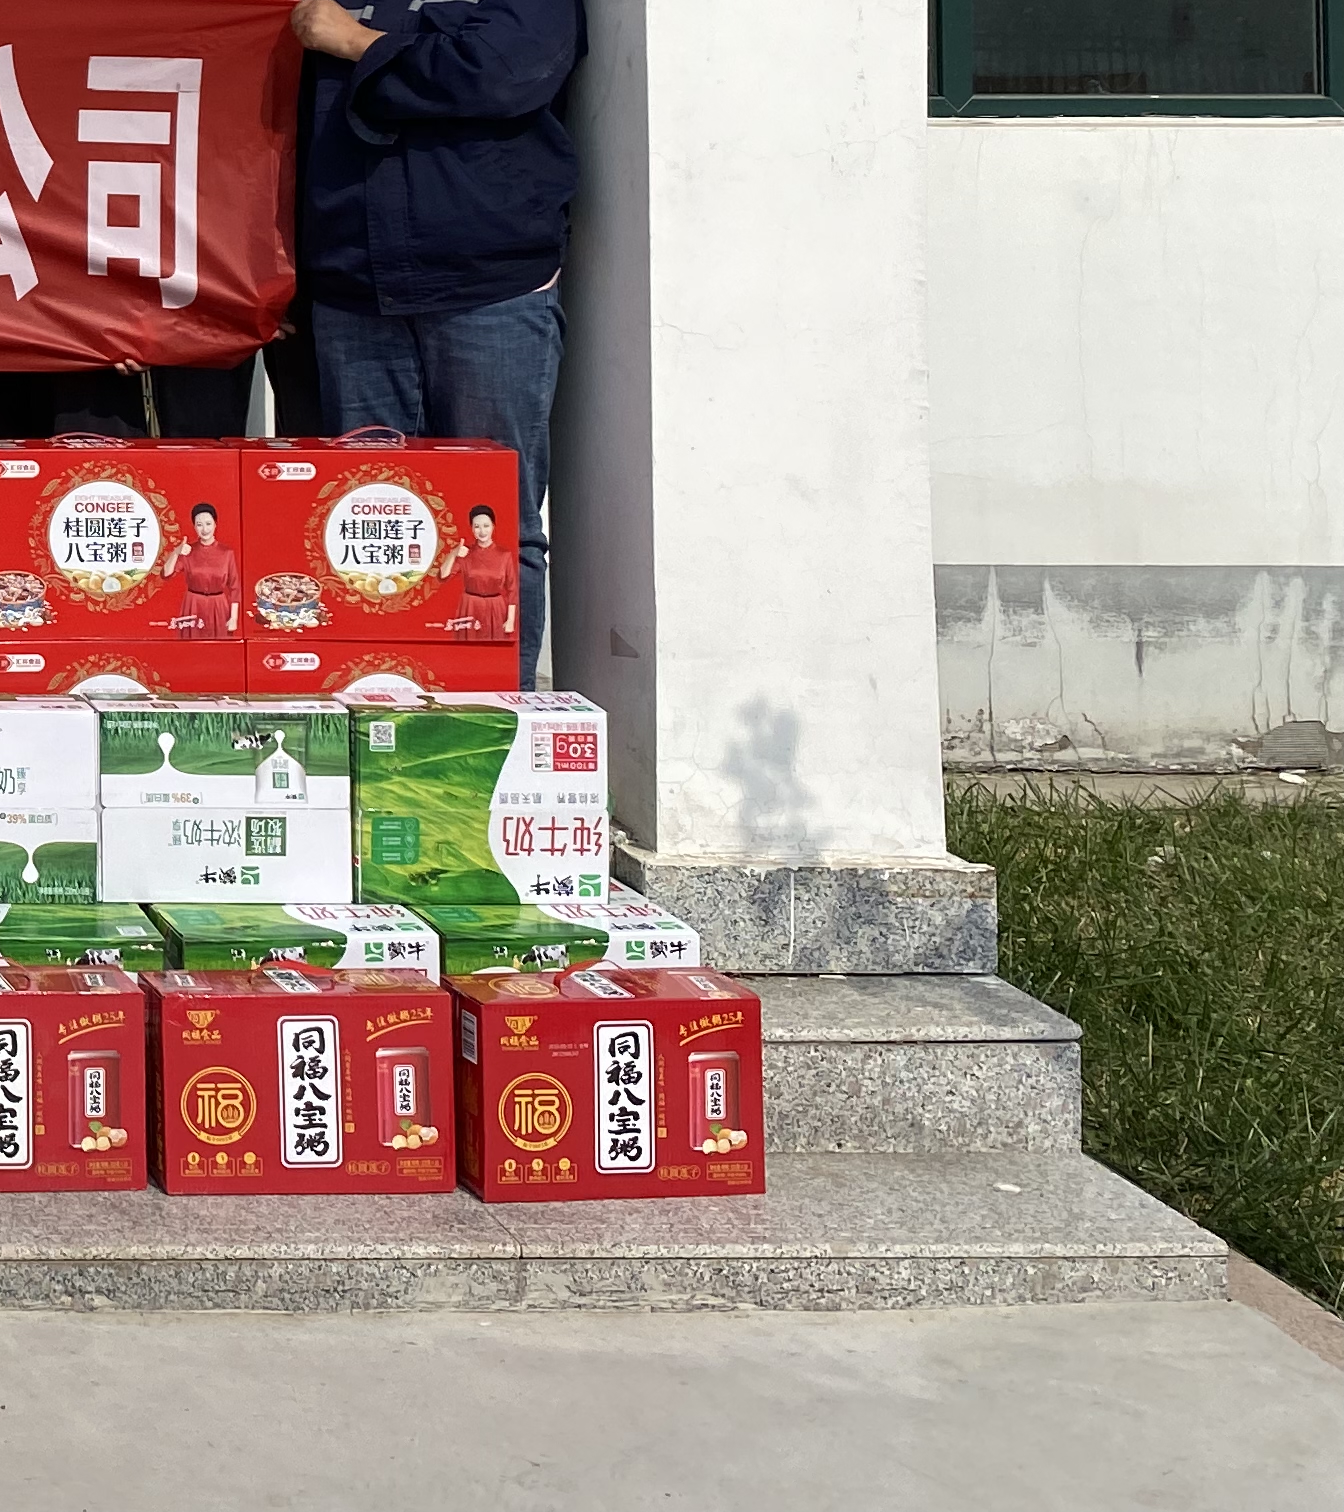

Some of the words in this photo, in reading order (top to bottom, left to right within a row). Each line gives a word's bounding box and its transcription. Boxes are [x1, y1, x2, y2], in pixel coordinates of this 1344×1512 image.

[74, 502, 134, 513] CONGEE
[351, 504, 411, 516] CONGEE
[63, 517, 148, 539] 桂圆莲子
[339, 519, 425, 541] 桂圆莲子
[64, 542, 128, 564] 八宝粥
[340, 543, 404, 566] 八宝粥
[290, 1026, 332, 1157] 同福八宝粥
[605, 1031, 645, 1161] 同福八宝粥
[197, 1083, 244, 1128] 福
[513, 1089, 561, 1135] 福
